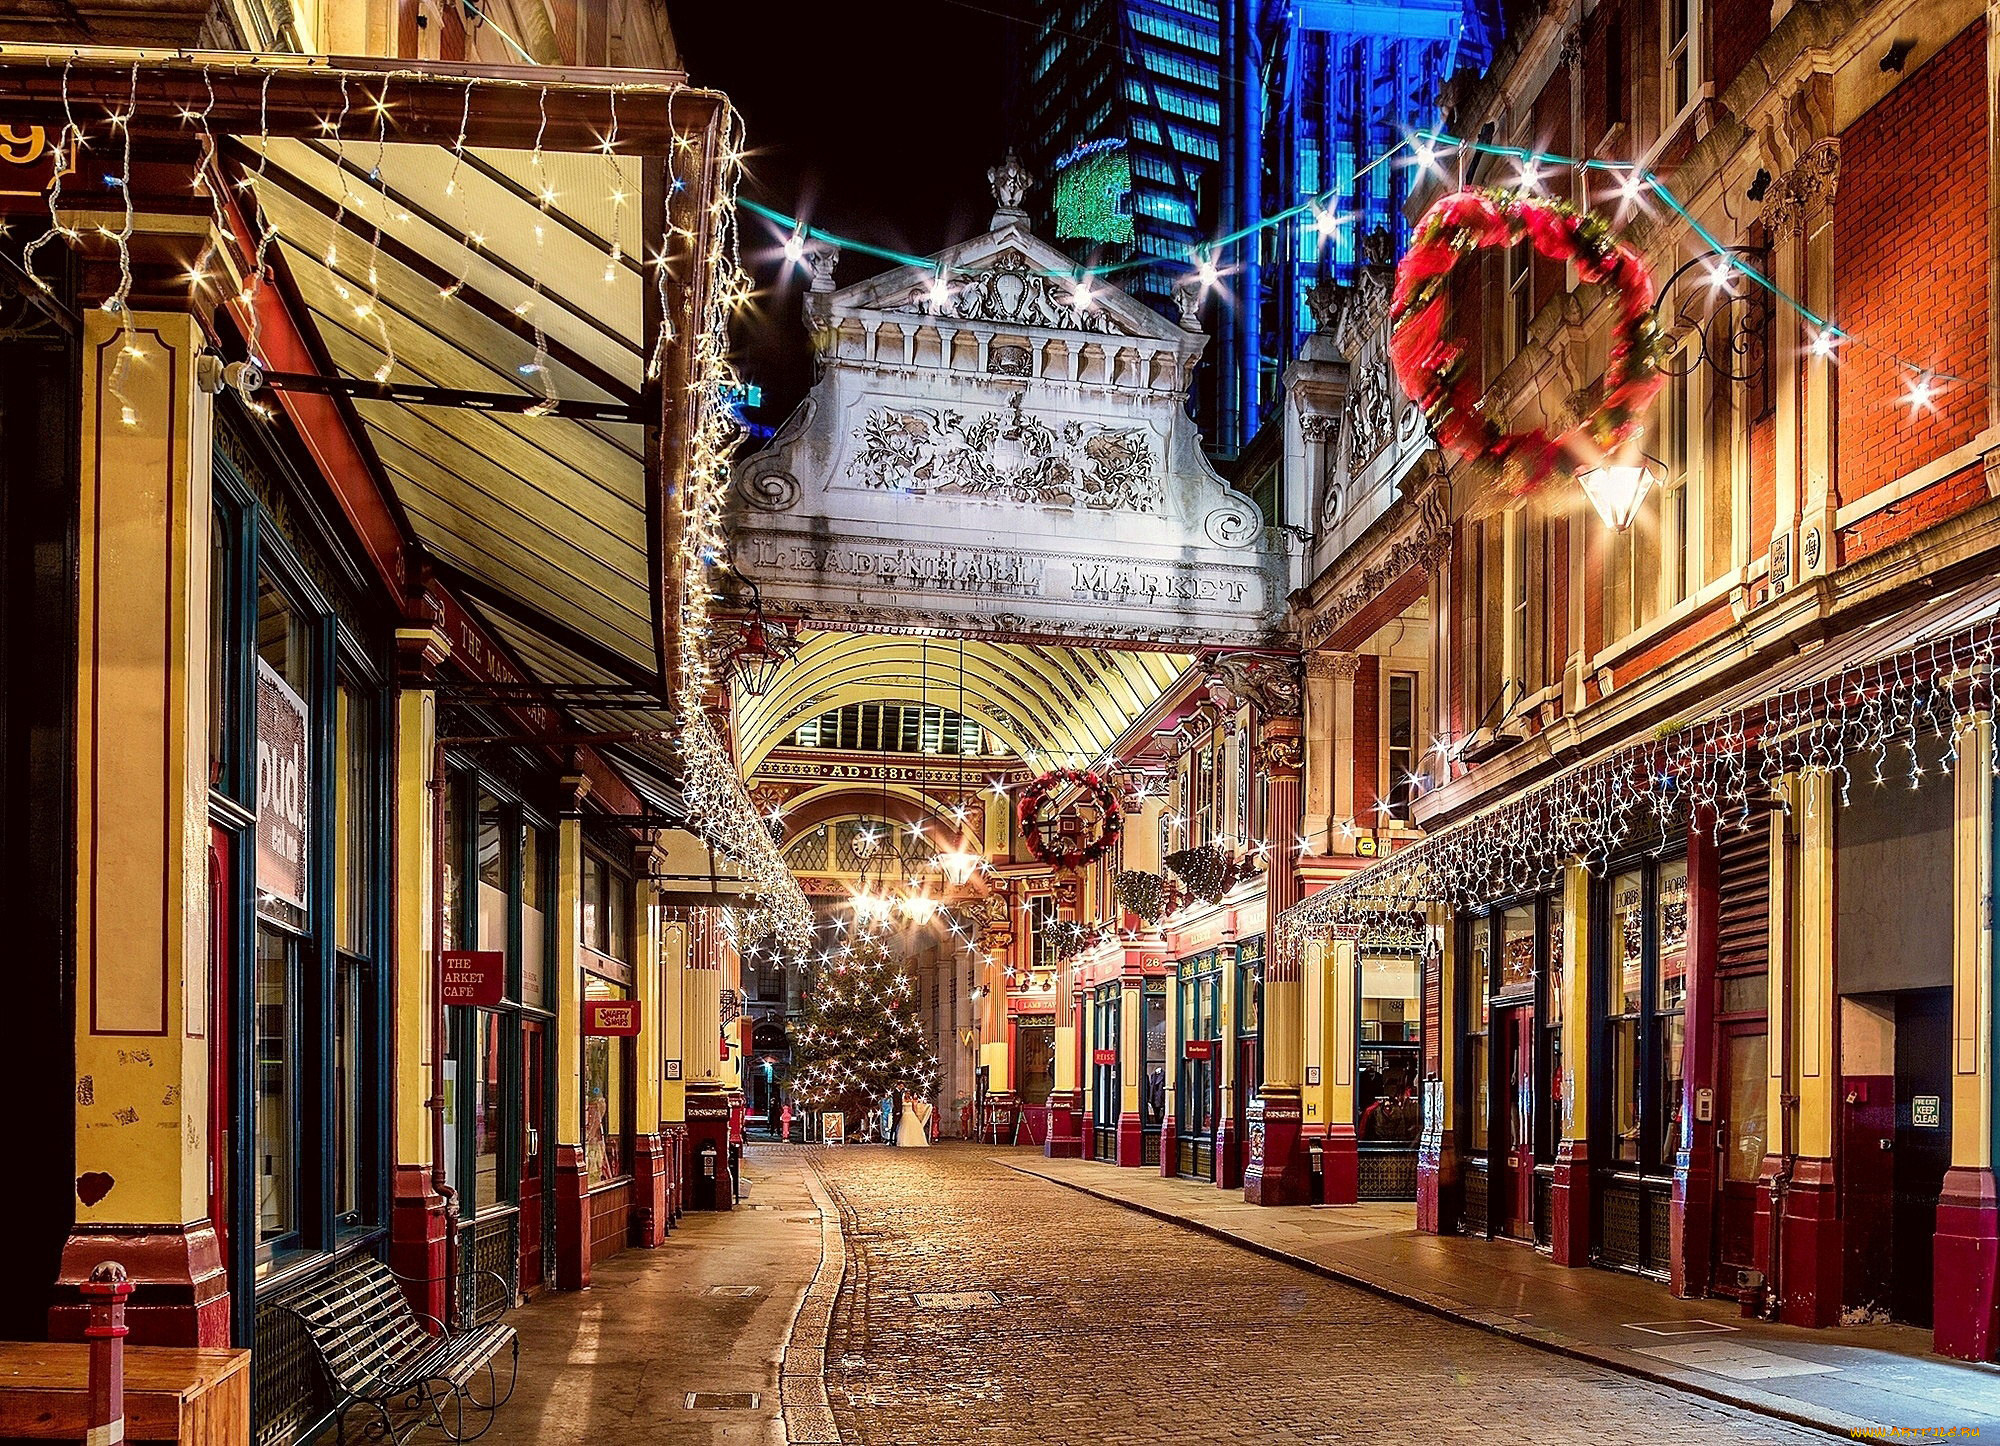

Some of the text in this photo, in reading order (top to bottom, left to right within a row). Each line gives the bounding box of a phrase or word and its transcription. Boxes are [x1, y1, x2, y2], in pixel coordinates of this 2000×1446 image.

[753, 537, 1248, 602] LEADENHALL MARKET
[461, 620, 481, 664] THE
[870, 766, 907, 780] 1881
[446, 958, 471, 969] THE
[1145, 958, 1160, 968] 26
[443, 984, 474, 997] CAFÉ
[1096, 1053, 1115, 1061] REISS
[1916, 1106, 1935, 1115] KEEP
[1914, 1115, 1938, 1124] CLEAR
